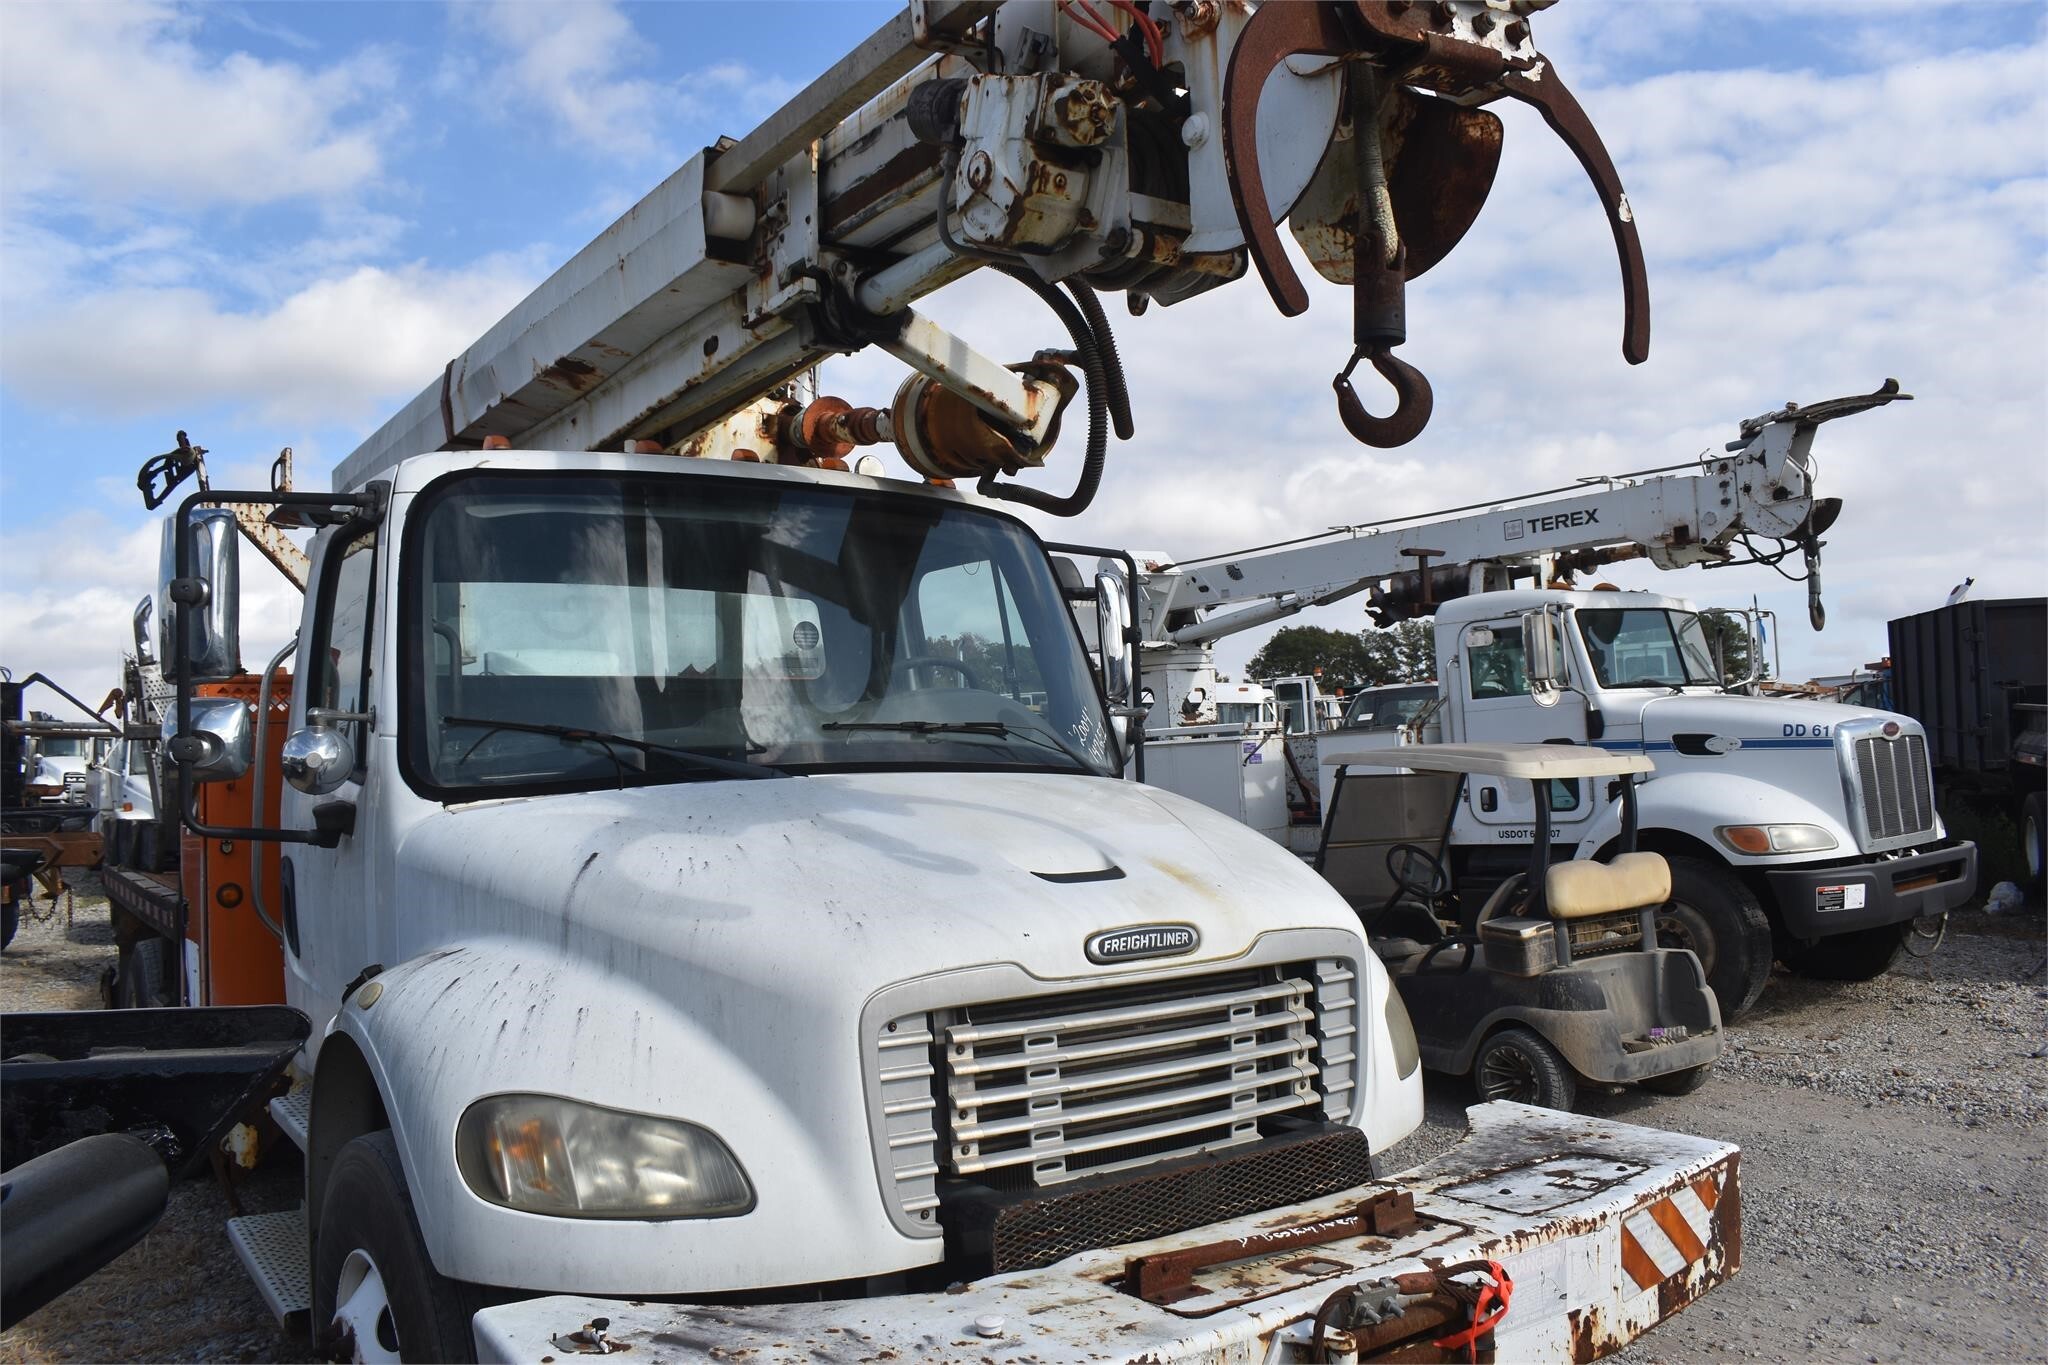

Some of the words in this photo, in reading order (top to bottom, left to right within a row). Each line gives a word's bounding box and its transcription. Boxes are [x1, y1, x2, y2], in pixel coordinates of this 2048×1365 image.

[1527, 508, 1599, 533] TEREX
[1783, 723, 1806, 737] DD
[1812, 724, 1830, 737] 61
[1498, 830, 1529, 839] USDOT
[1103, 932, 1190, 953] FREIGHTLINER
